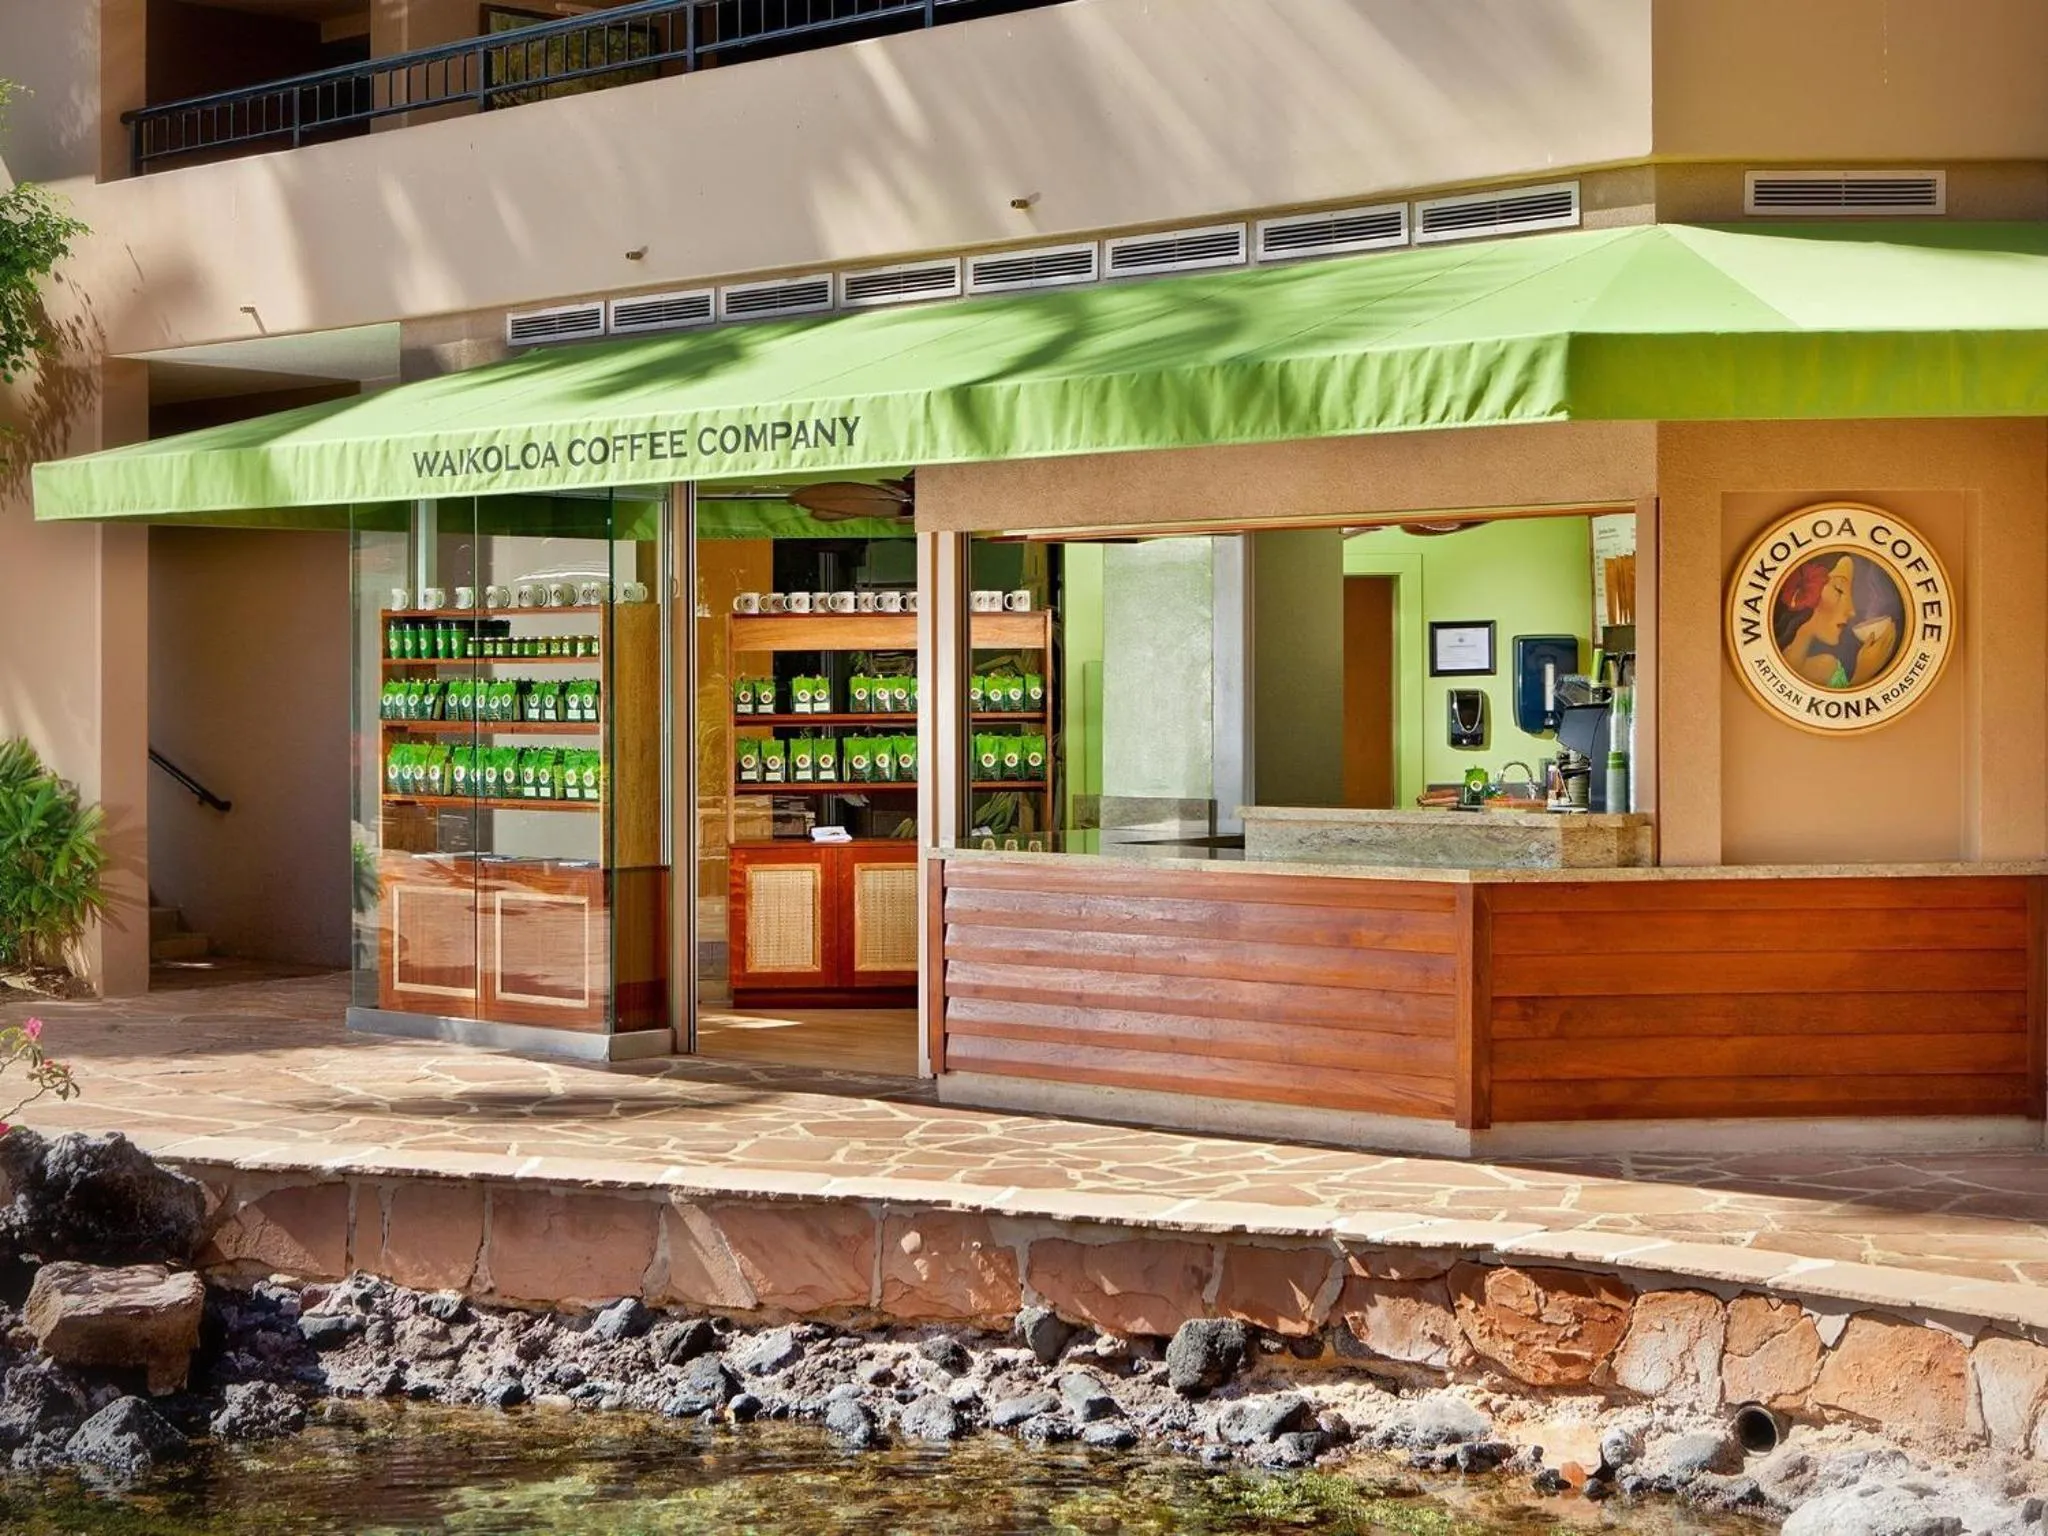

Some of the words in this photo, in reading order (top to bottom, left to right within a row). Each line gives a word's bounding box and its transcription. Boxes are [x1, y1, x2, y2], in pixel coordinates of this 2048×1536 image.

[413, 440, 561, 479] WAIKOLOA
[567, 429, 688, 467] COFFEE
[697, 416, 861, 457] COMPANY
[1740, 518, 1857, 646] WAIKOLOA
[1869, 525, 1943, 643] COFFEE
[1753, 657, 1804, 706] ARTISAN
[1806, 696, 1881, 719] KONA
[1881, 651, 1931, 705] ROASTER
